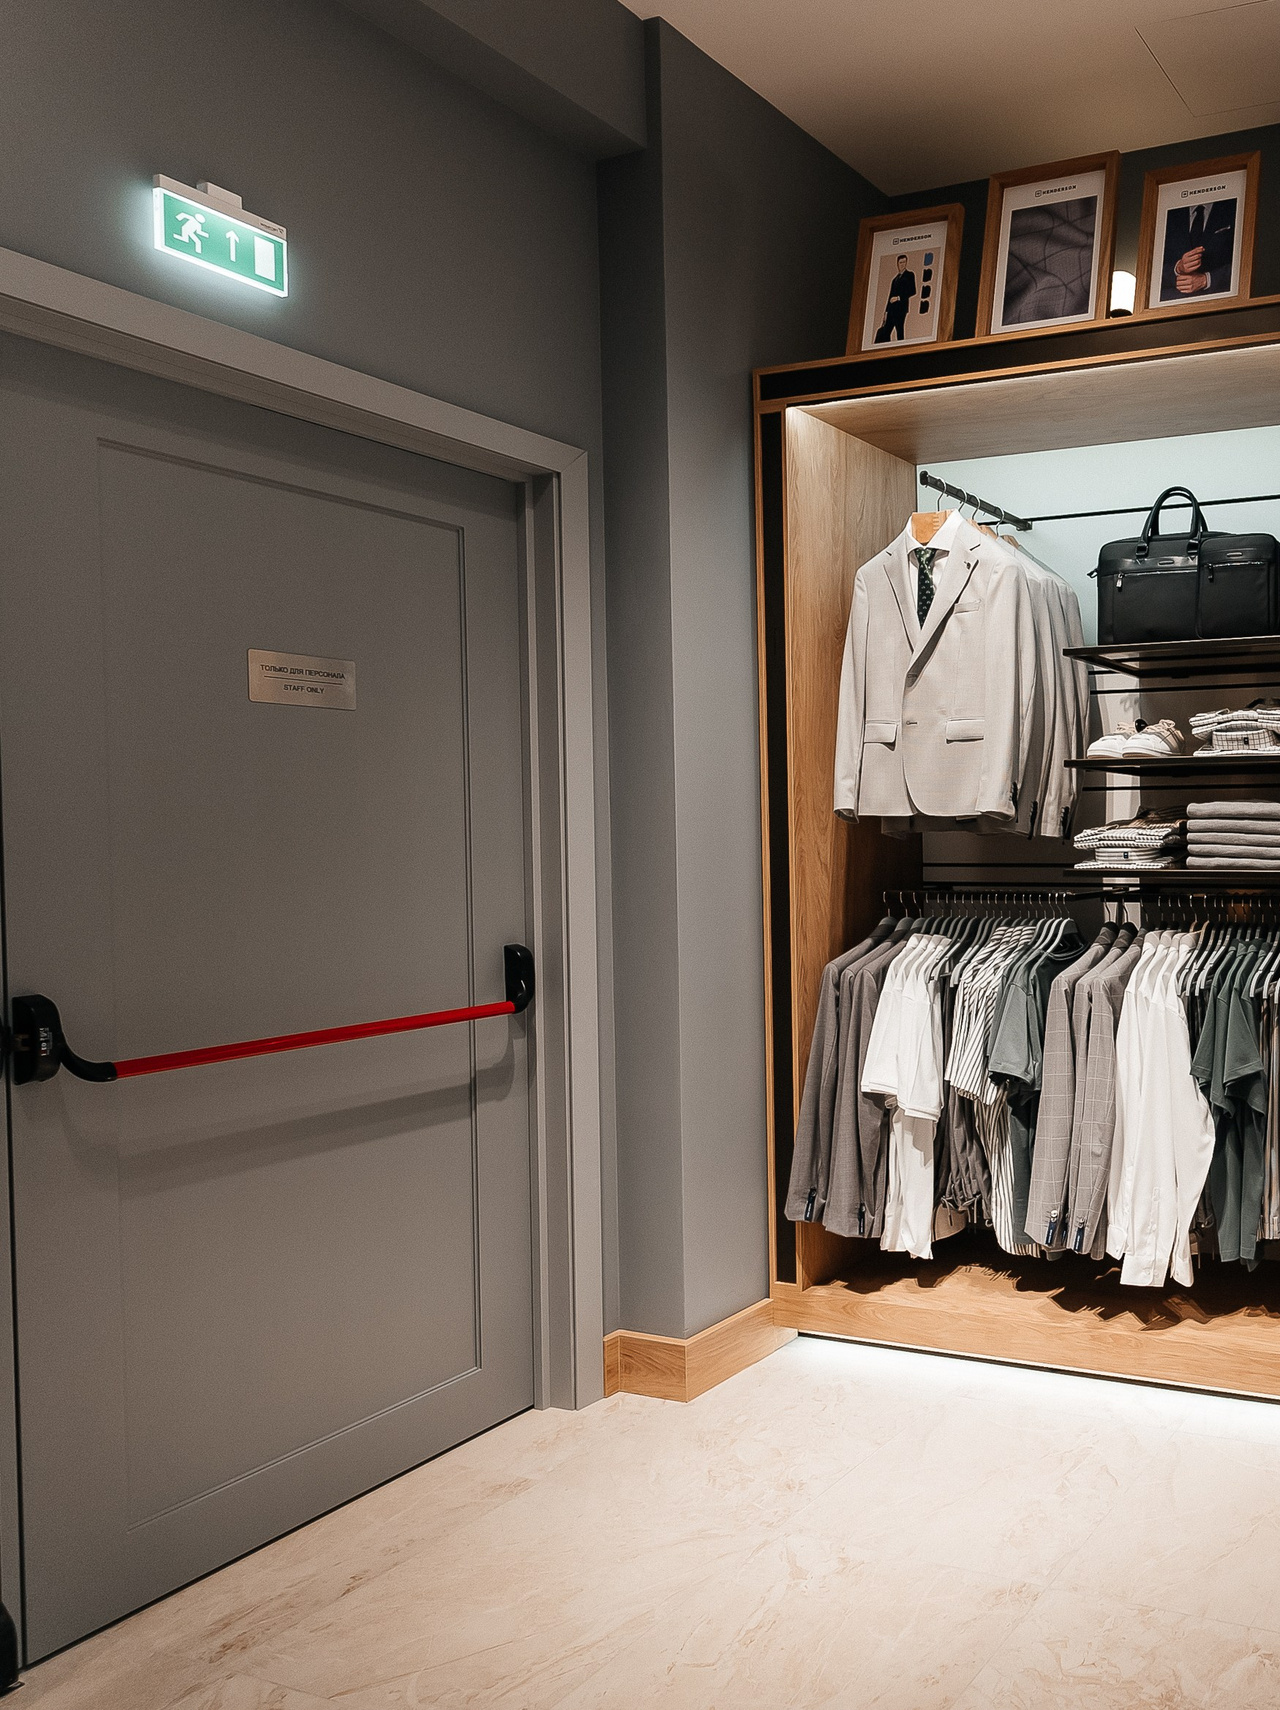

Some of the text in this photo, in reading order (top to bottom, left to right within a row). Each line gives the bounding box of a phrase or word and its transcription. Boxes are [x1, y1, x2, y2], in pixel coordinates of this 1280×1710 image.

[1189, 185, 1226, 196] HENDERSON
[899, 234, 932, 243] HENDERSON
[260, 664, 345, 679] ТОЛЬКО ДЛЯ ПЕРСОНАЛА
[283, 684, 325, 694] STAFF ONLY
